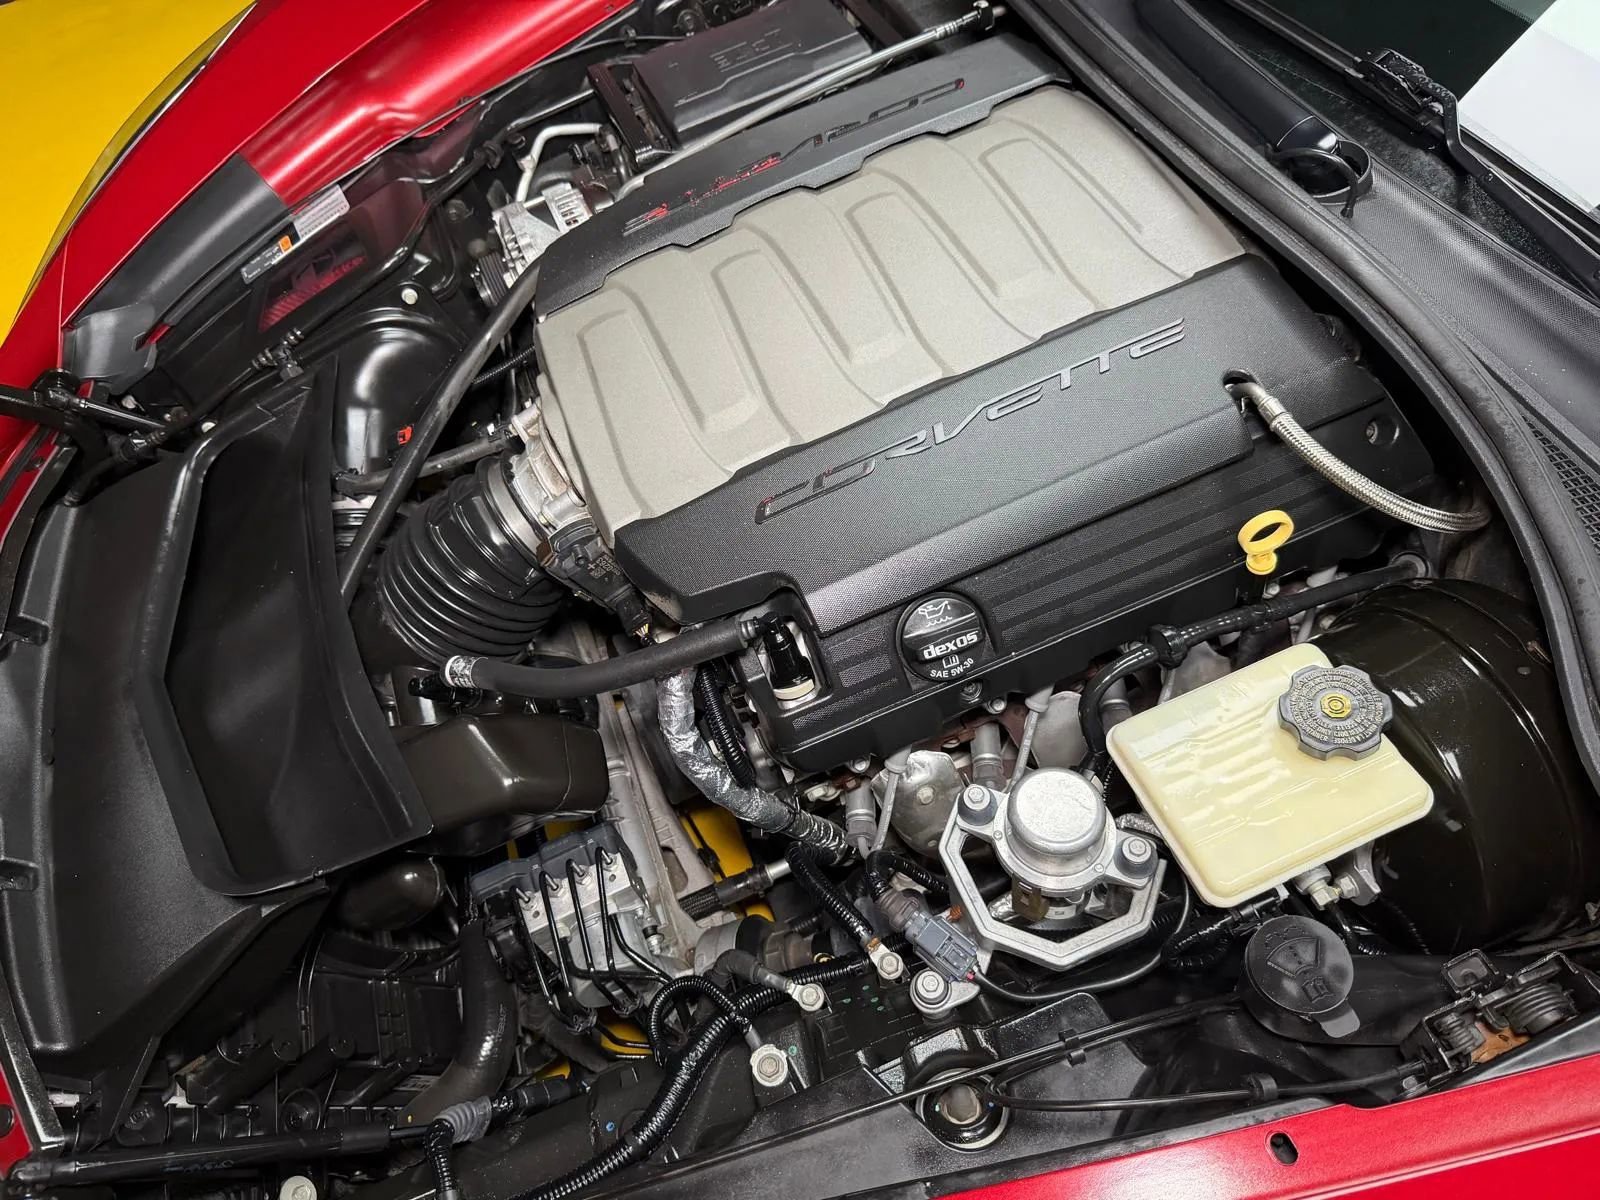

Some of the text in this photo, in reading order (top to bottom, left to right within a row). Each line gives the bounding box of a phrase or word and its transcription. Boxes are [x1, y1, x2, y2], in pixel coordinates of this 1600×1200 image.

[754, 317, 1185, 524] CORVETTE
[923, 631, 978, 659] dexos
[930, 657, 974, 678] SAE 5W-30
